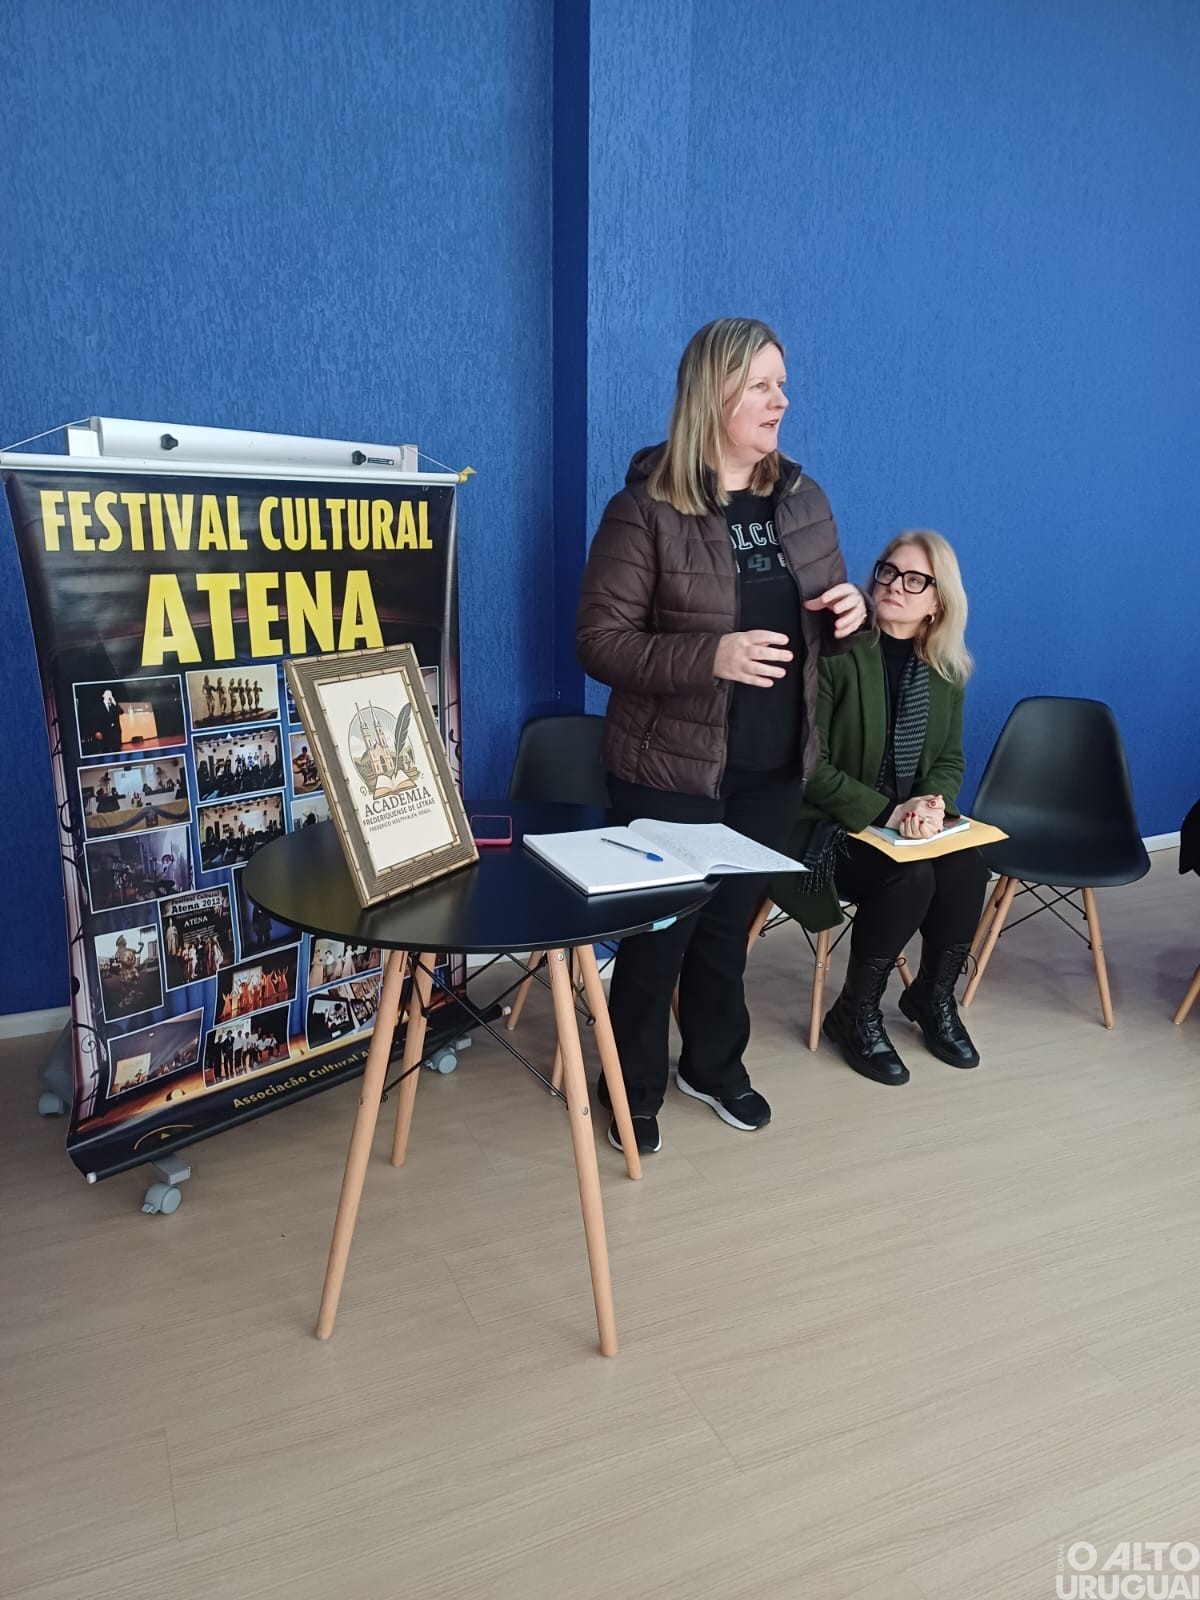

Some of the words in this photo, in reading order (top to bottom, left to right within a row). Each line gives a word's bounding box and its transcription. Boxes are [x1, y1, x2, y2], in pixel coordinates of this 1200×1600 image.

[39, 489, 248, 552] FESTIVAL
[259, 496, 433, 551] CULTURAL
[140, 569, 385, 667] ATENA
[362, 806, 408, 827] FREDERIQUENSE
[408, 804, 416, 812] DE
[416, 798, 435, 809] LETRAS
[365, 786, 431, 817] ACADEMIA
[171, 902, 200, 914] Atena
[201, 897, 221, 907] 2012
[184, 915, 208, 928] ATENA
[308, 1054, 360, 1079] Cultural
